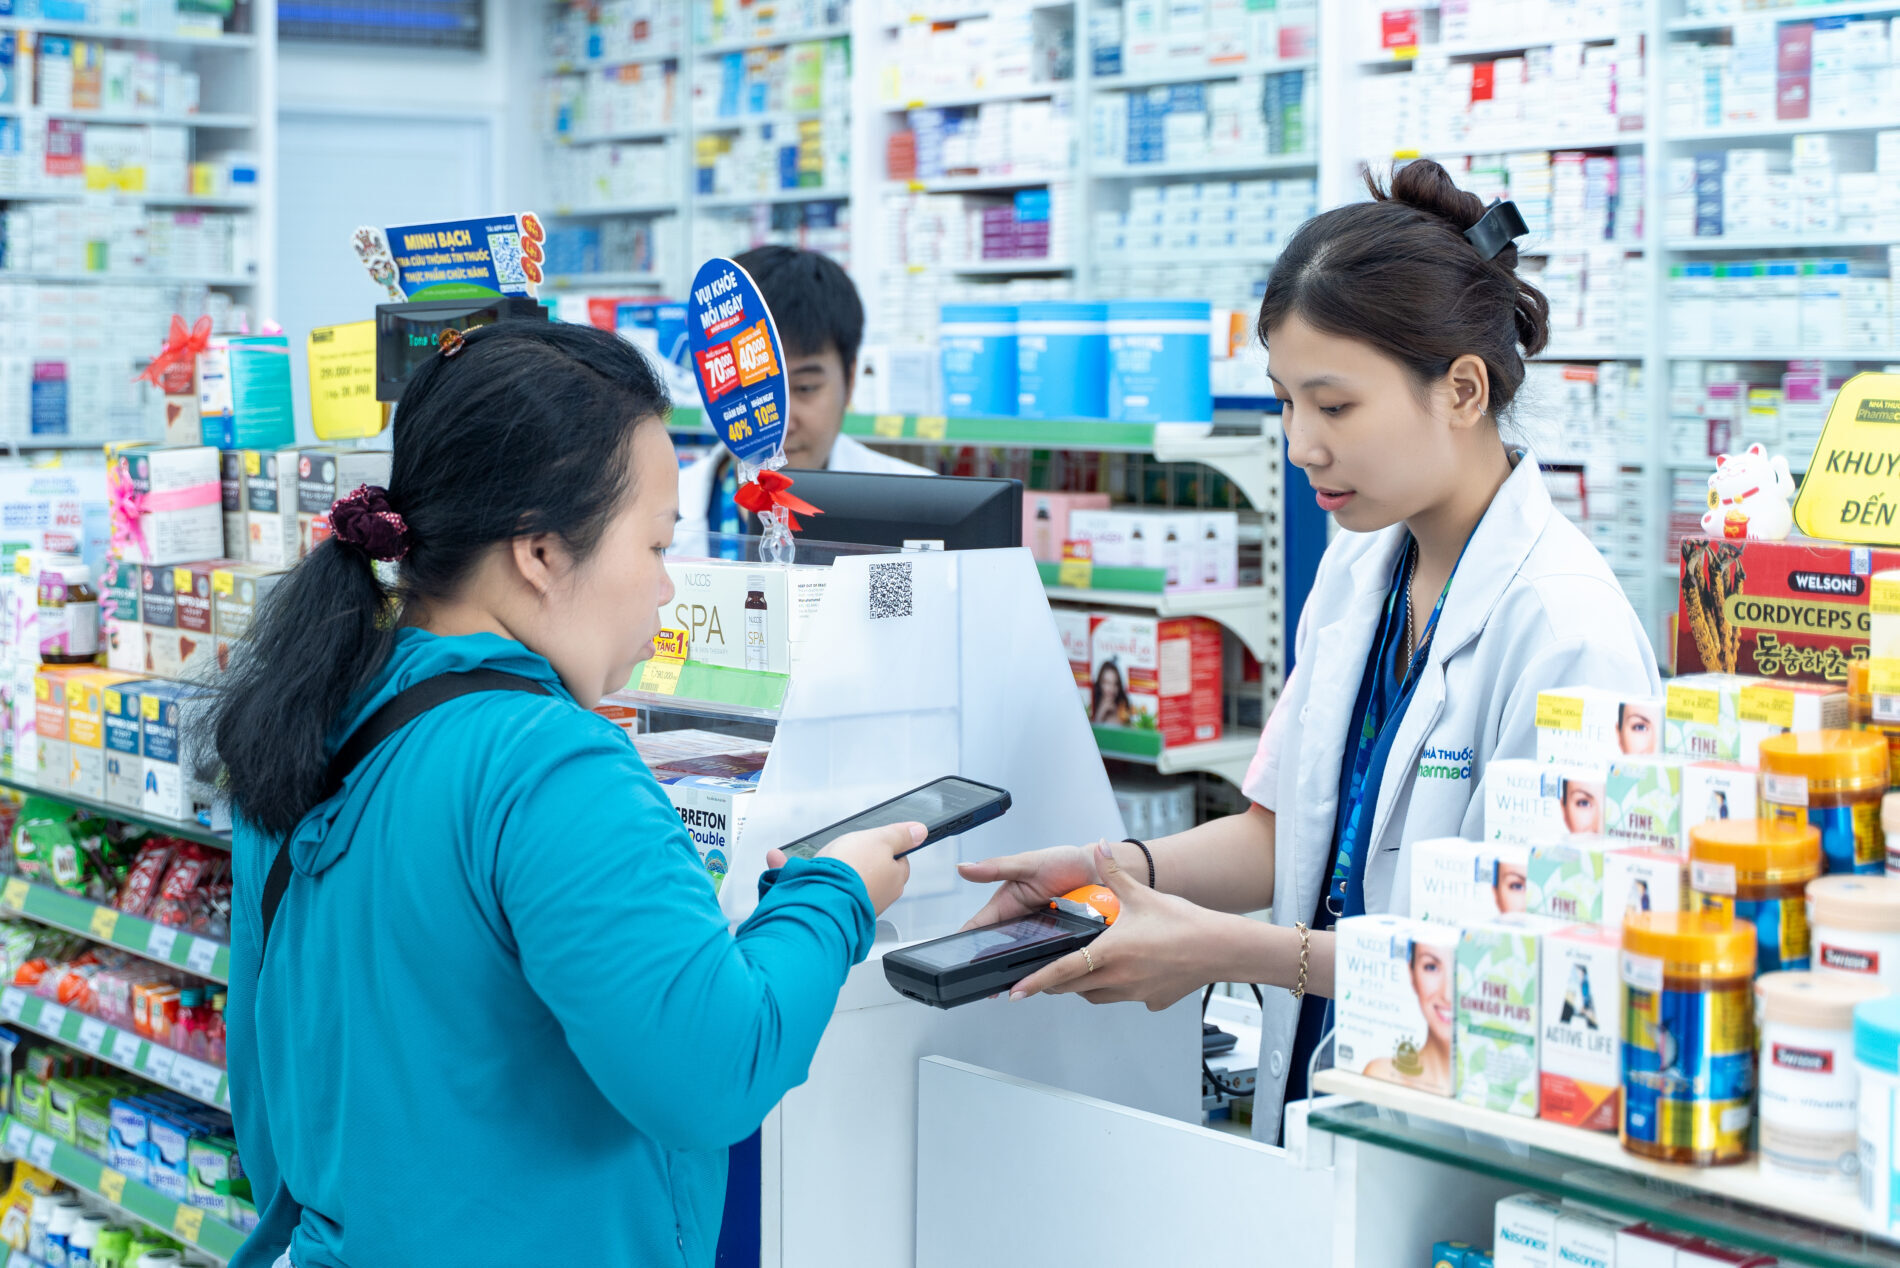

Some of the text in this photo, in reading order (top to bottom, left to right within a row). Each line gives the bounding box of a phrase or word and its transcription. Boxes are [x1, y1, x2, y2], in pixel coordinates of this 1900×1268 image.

[404, 229, 472, 252] MINH BẠCH
[695, 269, 738, 306] VUI KHỎE
[700, 293, 744, 330] MỖI NGÀY
[739, 343, 756, 372] 40
[705, 357, 726, 388] 70
[754, 406, 768, 427] 10
[1857, 409, 1900, 421] Pharmac
[728, 418, 753, 442] 40%
[1825, 450, 1900, 477] KHUY
[1840, 492, 1897, 526] ĐẾN
[684, 573, 712, 588] NUCOS
[1795, 574, 1852, 593] WELSON
[675, 603, 725, 646] SPA
[1734, 601, 1871, 632] CORDYCEPS G
[656, 639, 676, 654] TẶNG
[676, 632, 684, 655] 1
[748, 631, 766, 646] SPA
[1438, 746, 1473, 760] THUỐC
[1691, 736, 1717, 756] FINE
[1496, 794, 1551, 818] WHITE
[1628, 813, 1653, 832] FINE
[688, 828, 726, 847] Double
[1552, 897, 1577, 915] FINE
[1346, 955, 1400, 982] WHITE
[1482, 980, 1508, 999] FINE
[1460, 997, 1531, 1022] GINKGO PLUS
[1546, 1025, 1584, 1048] ACTIVE
[1587, 1033, 1613, 1055] LIFE
[1500, 1227, 1549, 1251] Nasonex
[1558, 1245, 1608, 1268] Nasonex
